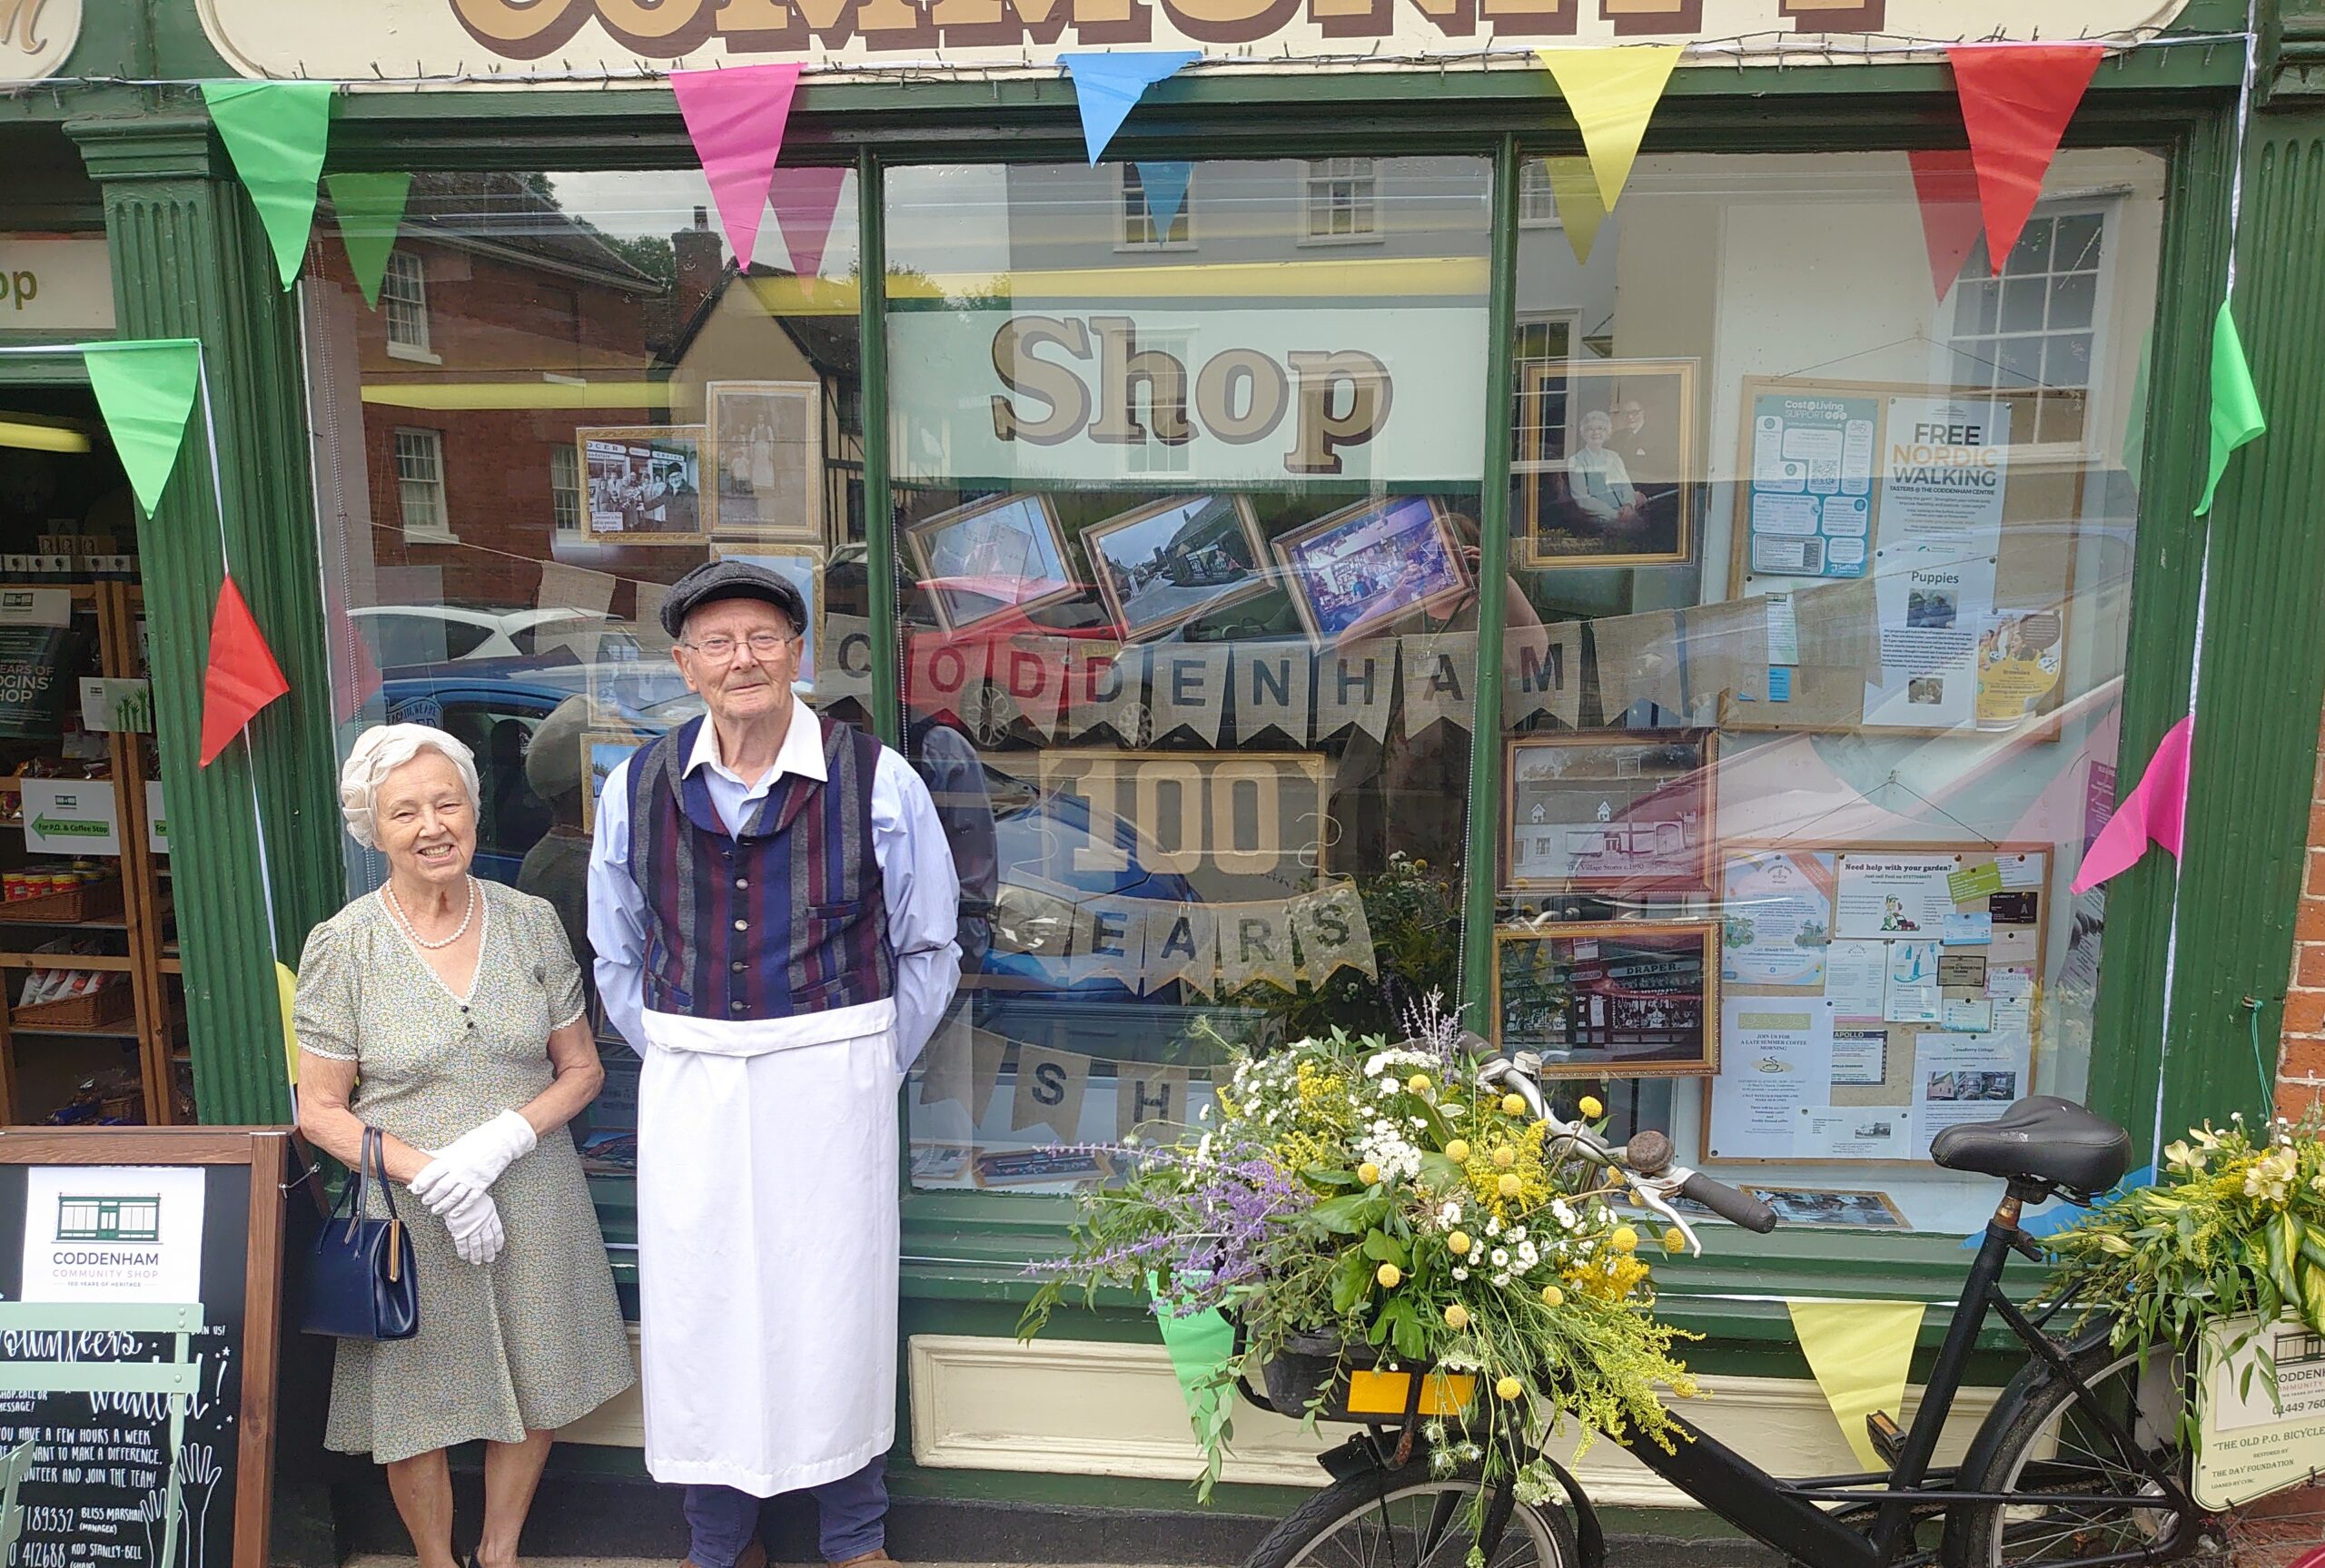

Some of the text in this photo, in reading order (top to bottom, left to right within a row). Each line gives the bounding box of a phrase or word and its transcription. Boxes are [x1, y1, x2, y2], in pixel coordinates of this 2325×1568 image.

[991, 315, 1392, 474] Shop
[1785, 399, 1807, 409] Cost
[1816, 400, 1844, 411] Living
[1785, 409, 1825, 419] SUPPORT
[1914, 423, 1981, 446] FREE
[1893, 444, 1997, 468] NORDIC
[1893, 467, 1996, 487] WALKING
[1911, 571, 1959, 585] Puppies
[35, 666, 55, 676] OF
[837, 633, 1564, 705] CODDENHAM
[1073, 759, 1281, 874] 100
[92, 825, 108, 833] Stop
[1866, 863, 1883, 872] help
[1923, 864, 1952, 873] garden?
[1627, 963, 1681, 975] DRAPER.
[53, 1252, 159, 1266] CODDENHAM
[53, 1269, 159, 1279] COMMUNITY SHOP
[213, 1326, 225, 1336] US!
[0, 1330, 143, 1362] olunteers
[2278, 1382, 2322, 1392] OMMUNITY
[38, 1391, 48, 1400] OR
[0, 1426, 151, 1445] OU HAVE A FEW HOURS A WEEK
[2240, 1436, 2260, 1447] OLD
[2262, 1434, 2280, 1445] P.O.
[2283, 1426, 2325, 1441] BICYCLE
[58, 1447, 68, 1461] TO
[72, 1446, 95, 1462] MAKE
[97, 1447, 104, 1461] A
[108, 1446, 163, 1465] DIFFERENCE.
[2252, 1450, 2280, 1458] RESTORED
[2211, 1459, 2294, 1478] THE DAY FOUNDATION
[63, 1467, 82, 1484] AND
[85, 1468, 106, 1484] JOIN
[110, 1467, 126, 1488] THE
[130, 1468, 157, 1489] TEAM!
[2211, 1482, 2232, 1490] LOANED
[26, 1505, 74, 1533] 189332
[81, 1507, 104, 1520] BLISS
[79, 1523, 118, 1535] (MANAGER)
[22, 1542, 66, 1568] 412688
[71, 1543, 86, 1555] ROD
[89, 1543, 143, 1560] STANLEY-BELL
